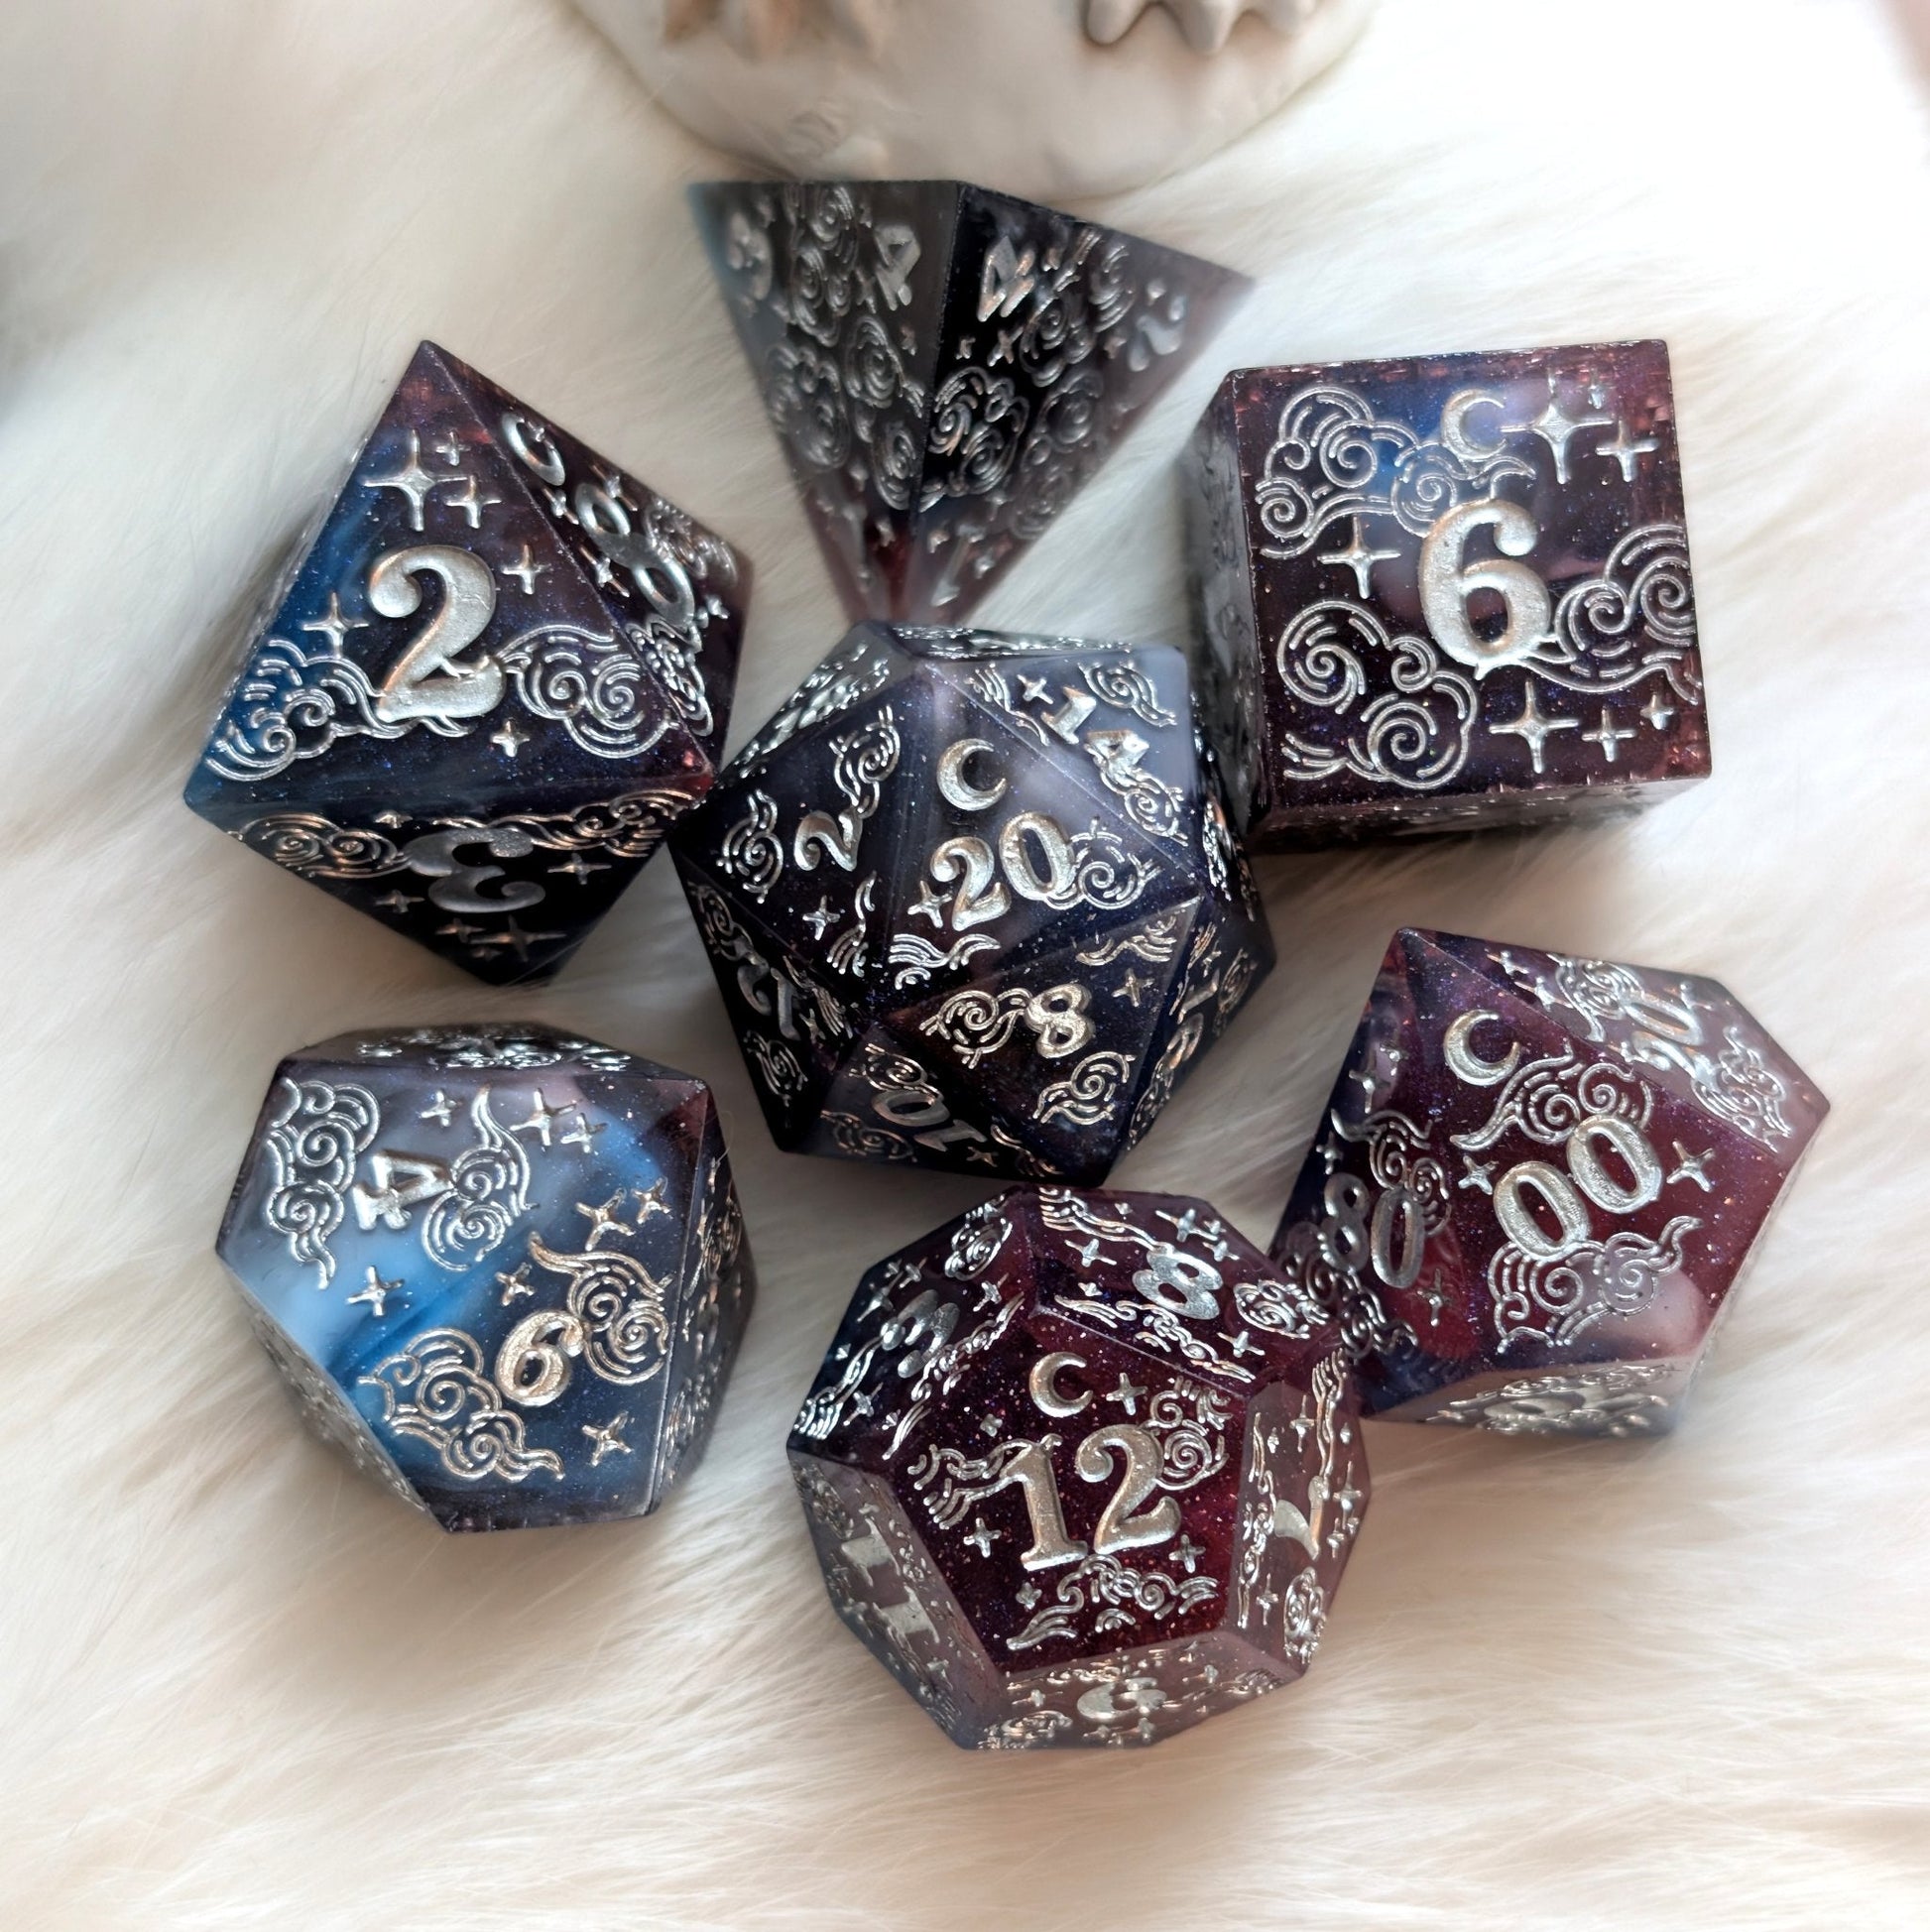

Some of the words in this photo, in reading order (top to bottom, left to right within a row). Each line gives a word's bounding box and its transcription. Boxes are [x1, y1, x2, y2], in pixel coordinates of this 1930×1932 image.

[874, 222, 921, 310] 4
[978, 235, 1034, 321] 4
[576, 483, 694, 630] 8
[1419, 499, 1551, 668] 6
[369, 545, 506, 722] 2
[1040, 687, 1150, 782] 14
[405, 827, 547, 913] 3
[794, 808, 862, 872] 2
[930, 811, 1075, 931] 20
[1025, 983, 1091, 1058] 8
[872, 1092, 987, 1150] 10
[352, 1149, 456, 1231] 4
[1323, 1173, 1425, 1287] 80
[1493, 1115, 1662, 1263] 00
[1133, 1249, 1223, 1319] 8
[495, 1310, 585, 1406] 6
[999, 1424, 1182, 1570] 12
